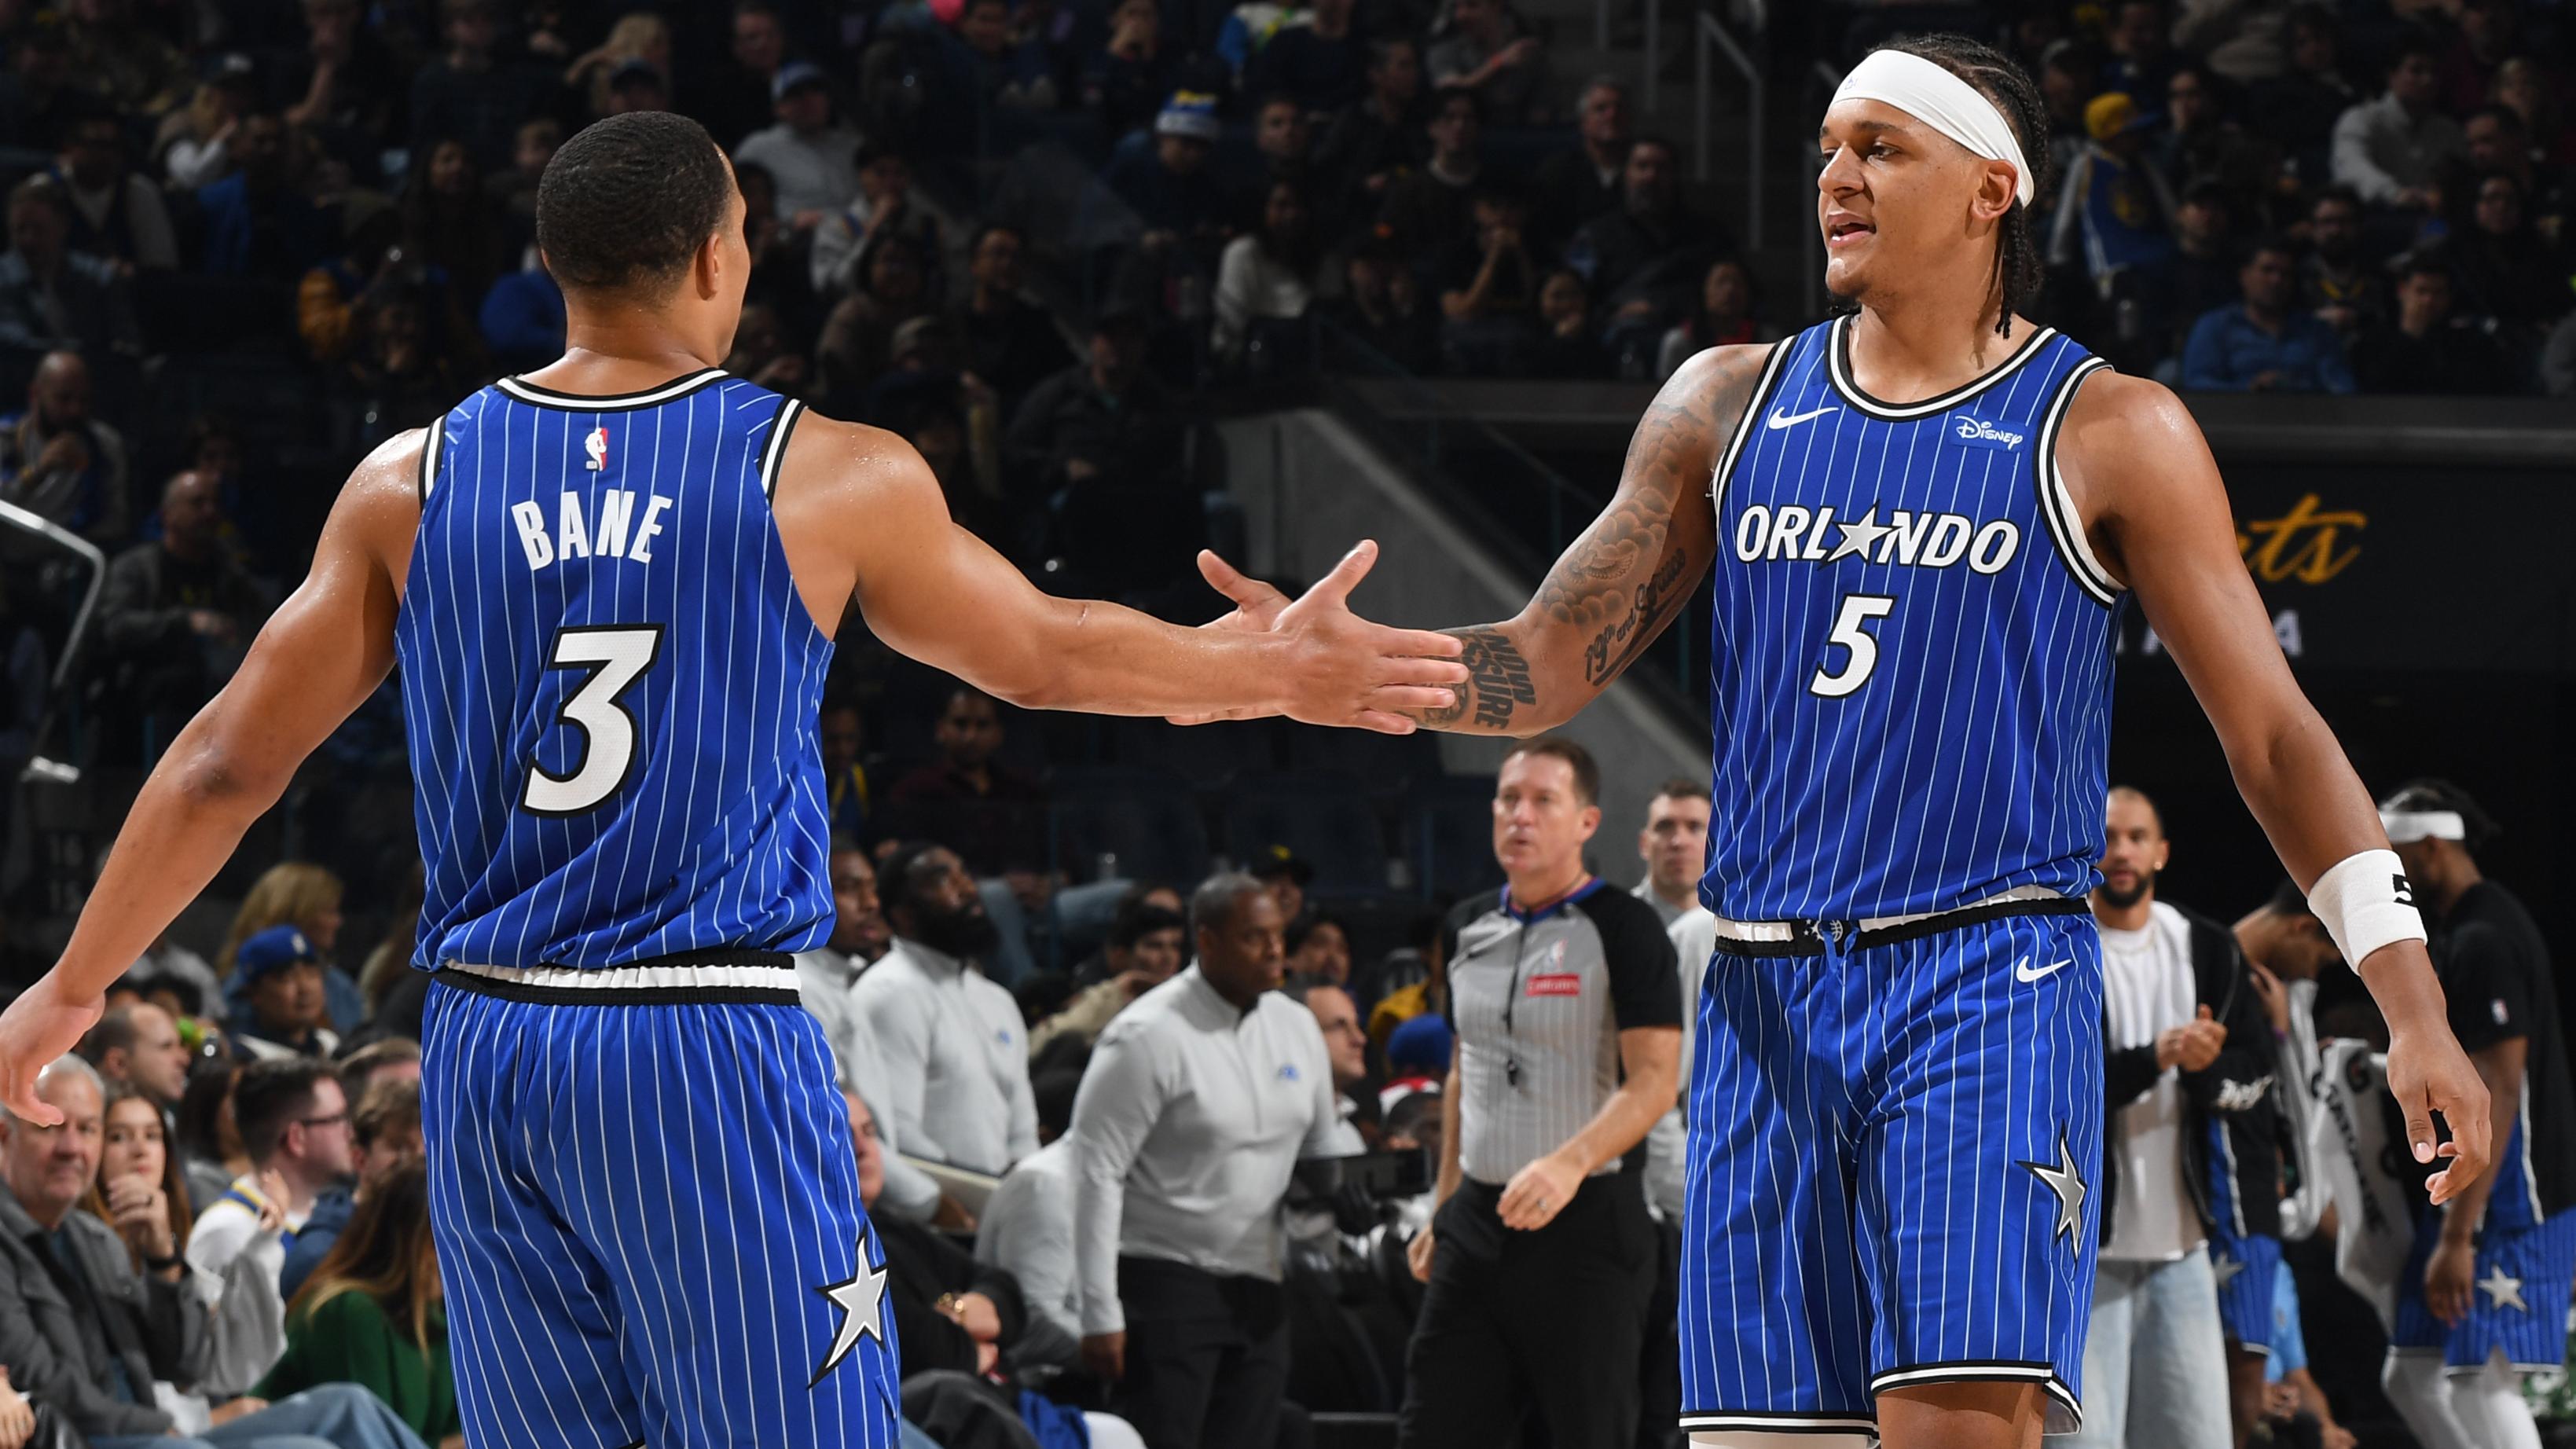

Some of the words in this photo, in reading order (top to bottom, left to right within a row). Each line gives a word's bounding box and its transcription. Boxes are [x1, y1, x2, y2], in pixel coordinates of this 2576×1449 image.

[1954, 415, 2024, 451] Disney
[511, 489, 673, 571] BANE
[1807, 593, 1898, 699] 5
[518, 623, 666, 818] 3
